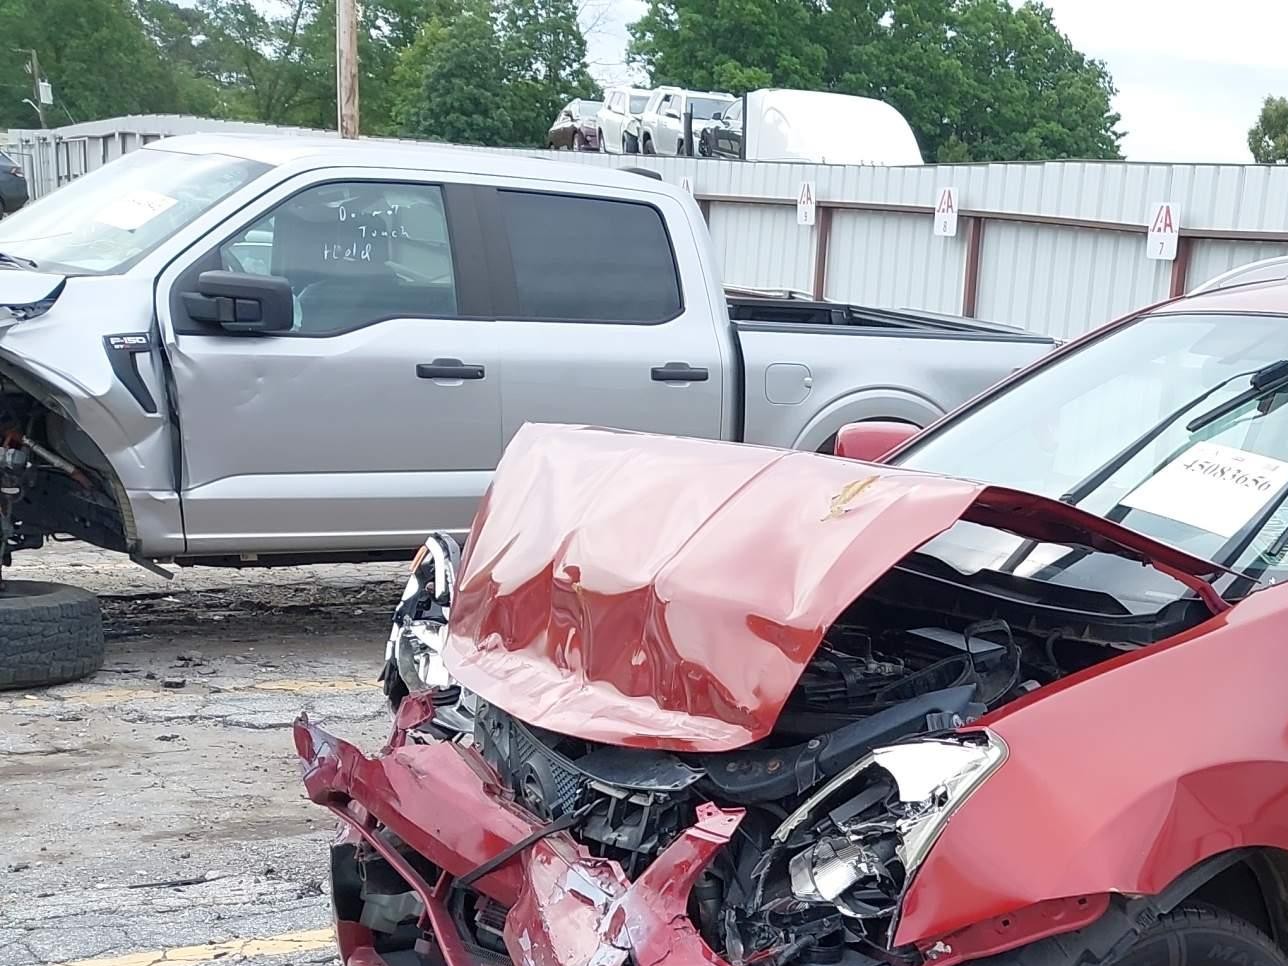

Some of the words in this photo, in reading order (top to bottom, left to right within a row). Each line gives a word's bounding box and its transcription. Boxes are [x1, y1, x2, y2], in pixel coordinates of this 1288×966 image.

[1159, 241, 1165, 256] 7
[109, 336, 147, 345] F-150
[1183, 459, 1271, 491] 45083656
